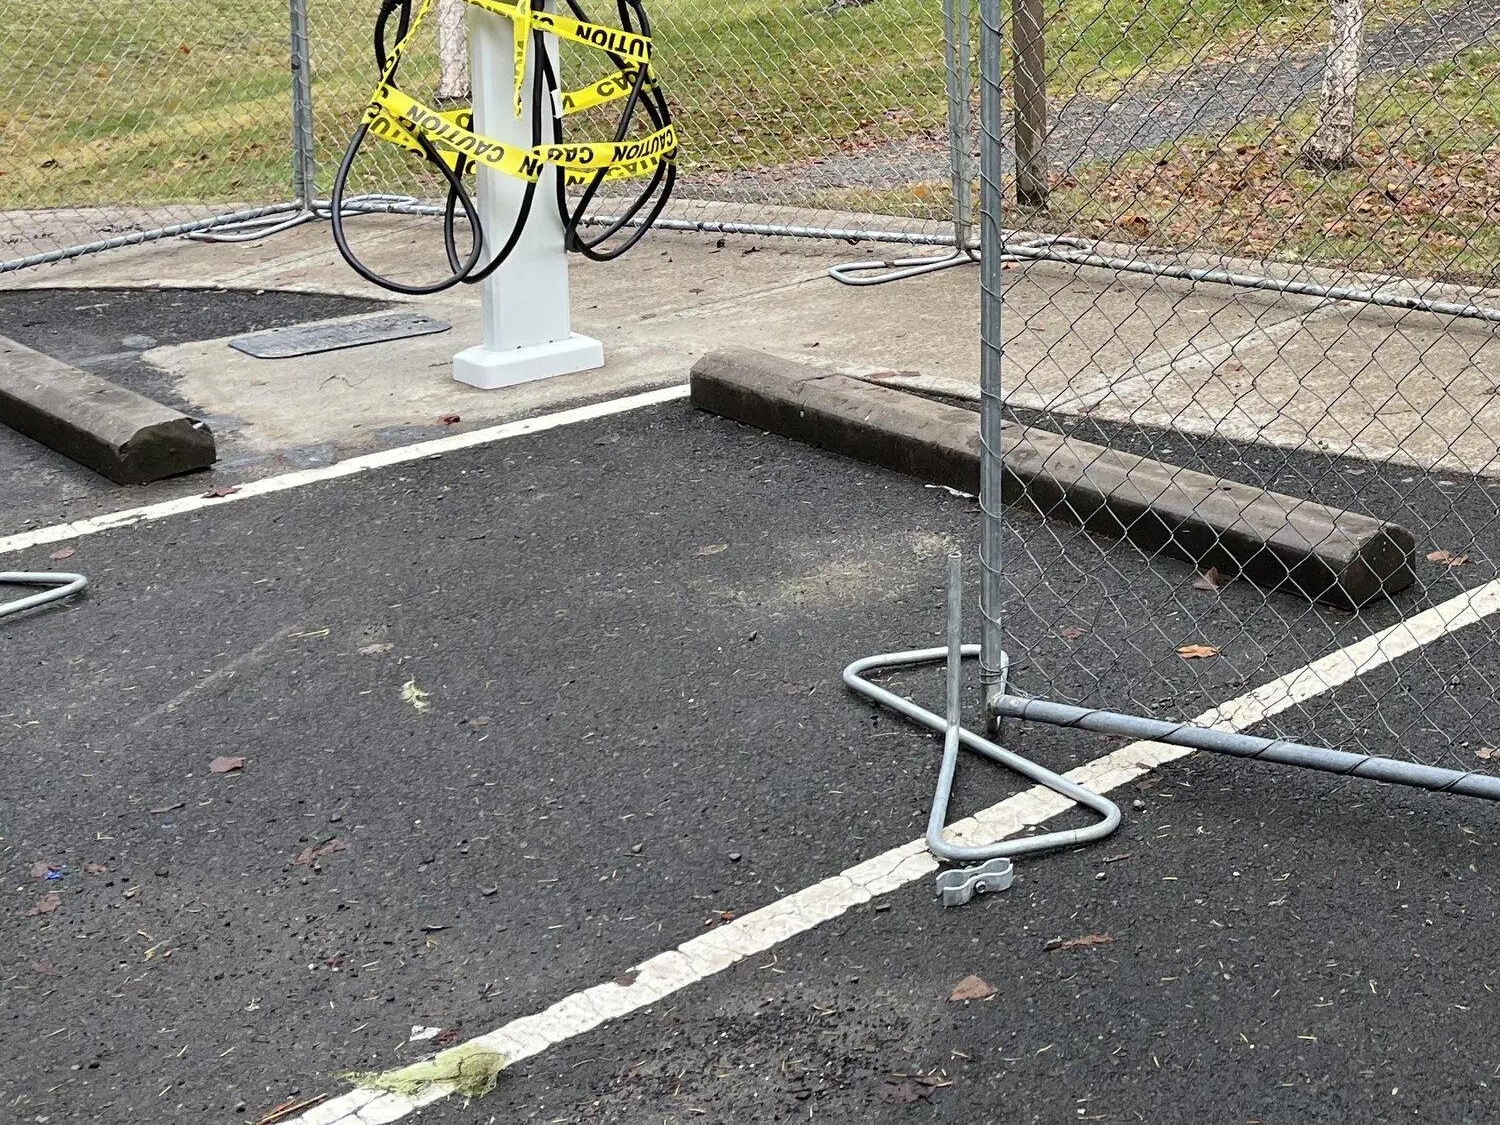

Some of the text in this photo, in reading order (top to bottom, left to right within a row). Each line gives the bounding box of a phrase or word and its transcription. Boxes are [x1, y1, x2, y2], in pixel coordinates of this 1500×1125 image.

[575, 24, 645, 58] UTION
[405, 104, 505, 163] CAUTION
[611, 129, 673, 162] CAUTION
